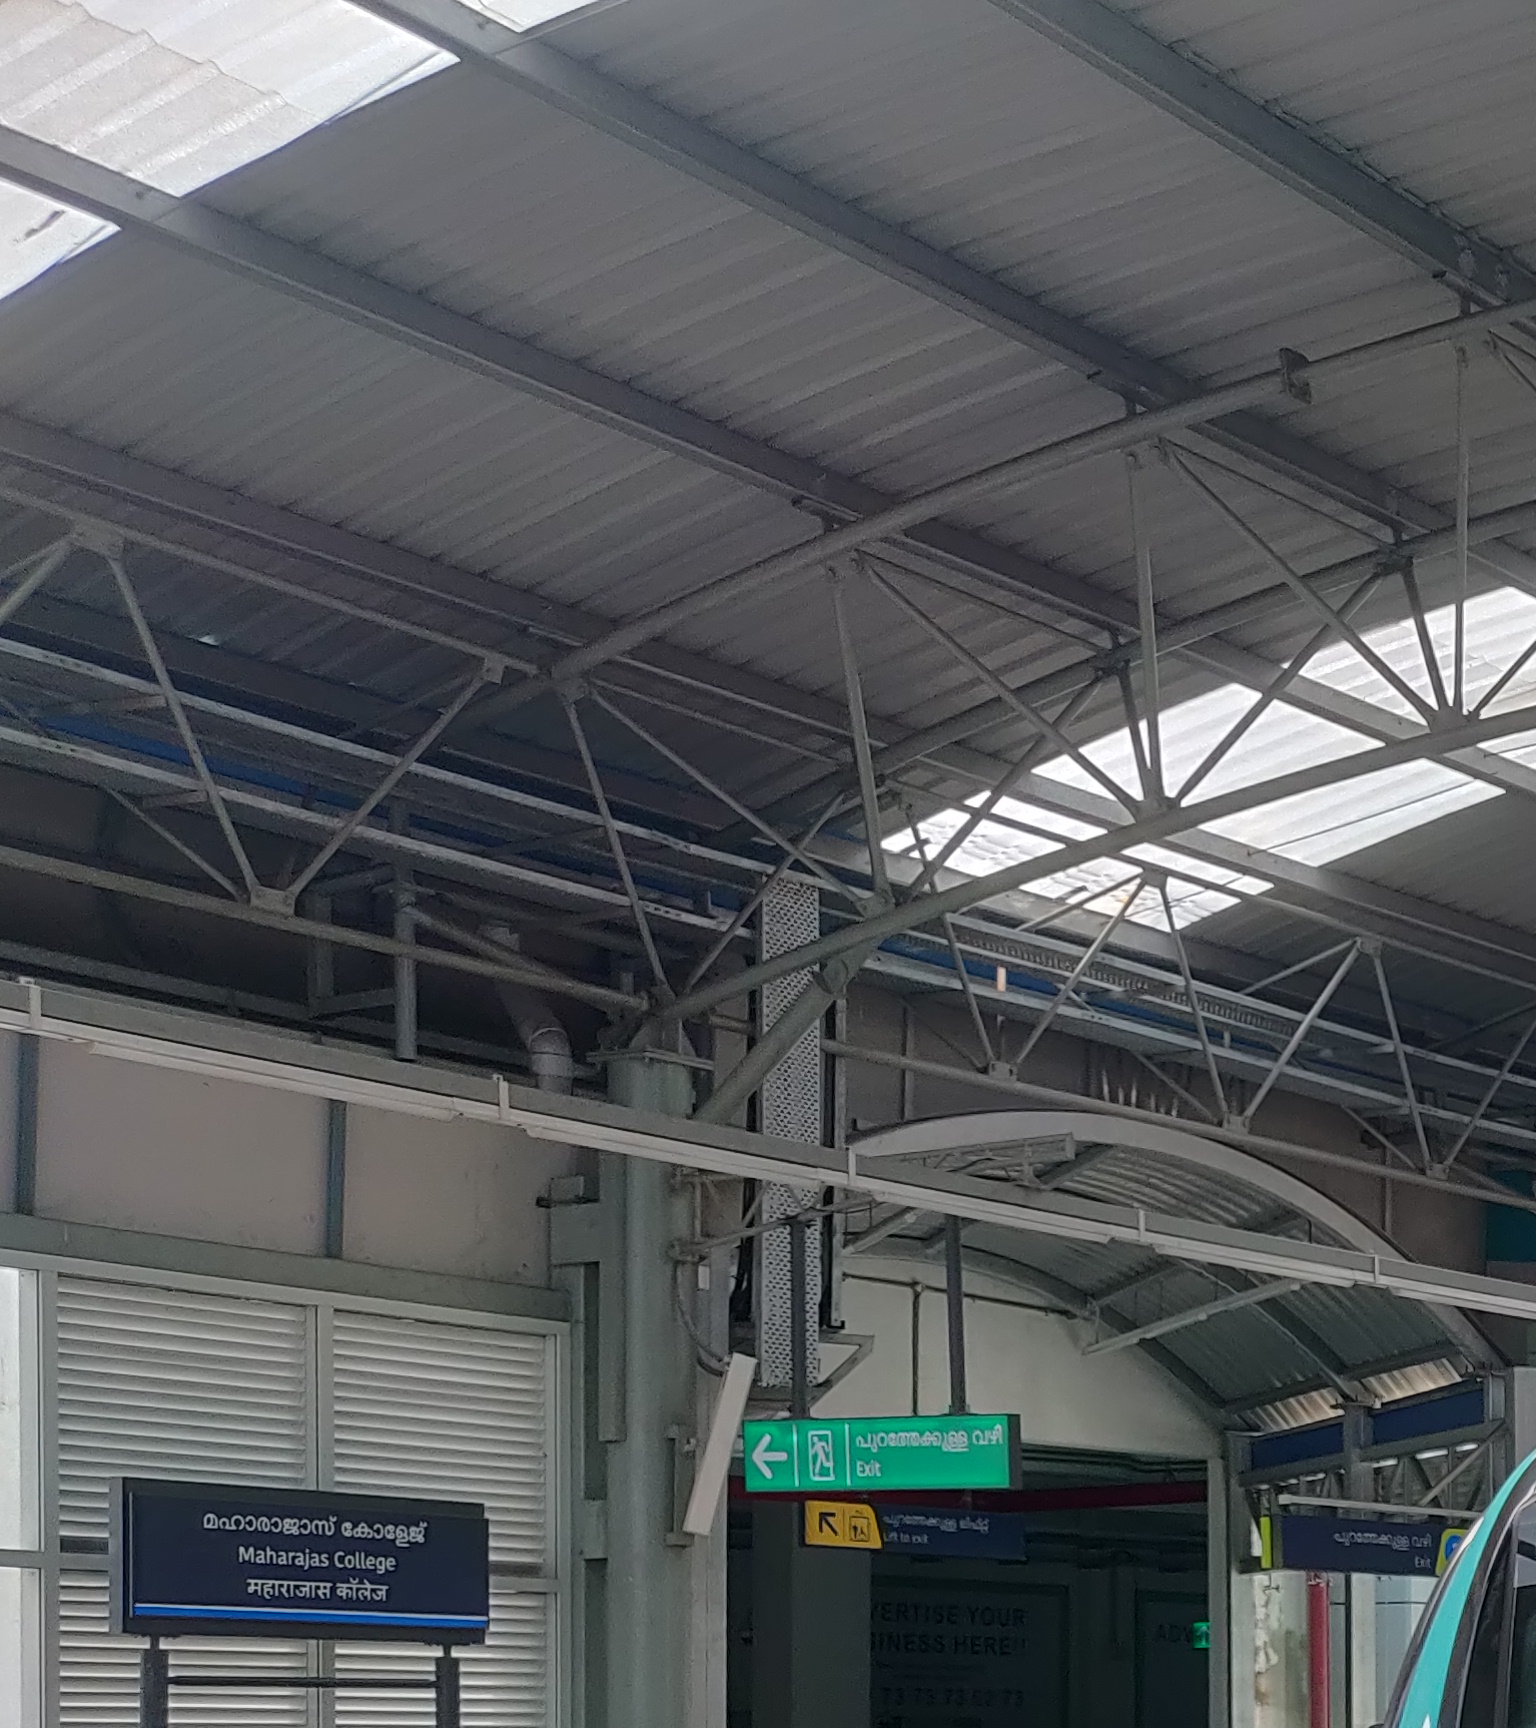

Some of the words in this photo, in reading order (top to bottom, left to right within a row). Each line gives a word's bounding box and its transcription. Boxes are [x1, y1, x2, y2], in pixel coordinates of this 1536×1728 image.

[856, 1459, 882, 1477] Exit
[203, 1513, 338, 1537] മഹാരാജാസ്
[340, 1520, 428, 1548] കോളേജ്
[238, 1545, 330, 1571] Maharajas
[333, 1550, 397, 1575] College
[246, 1578, 333, 1600] महाराजास
[336, 1577, 389, 1602] कॉलेज
